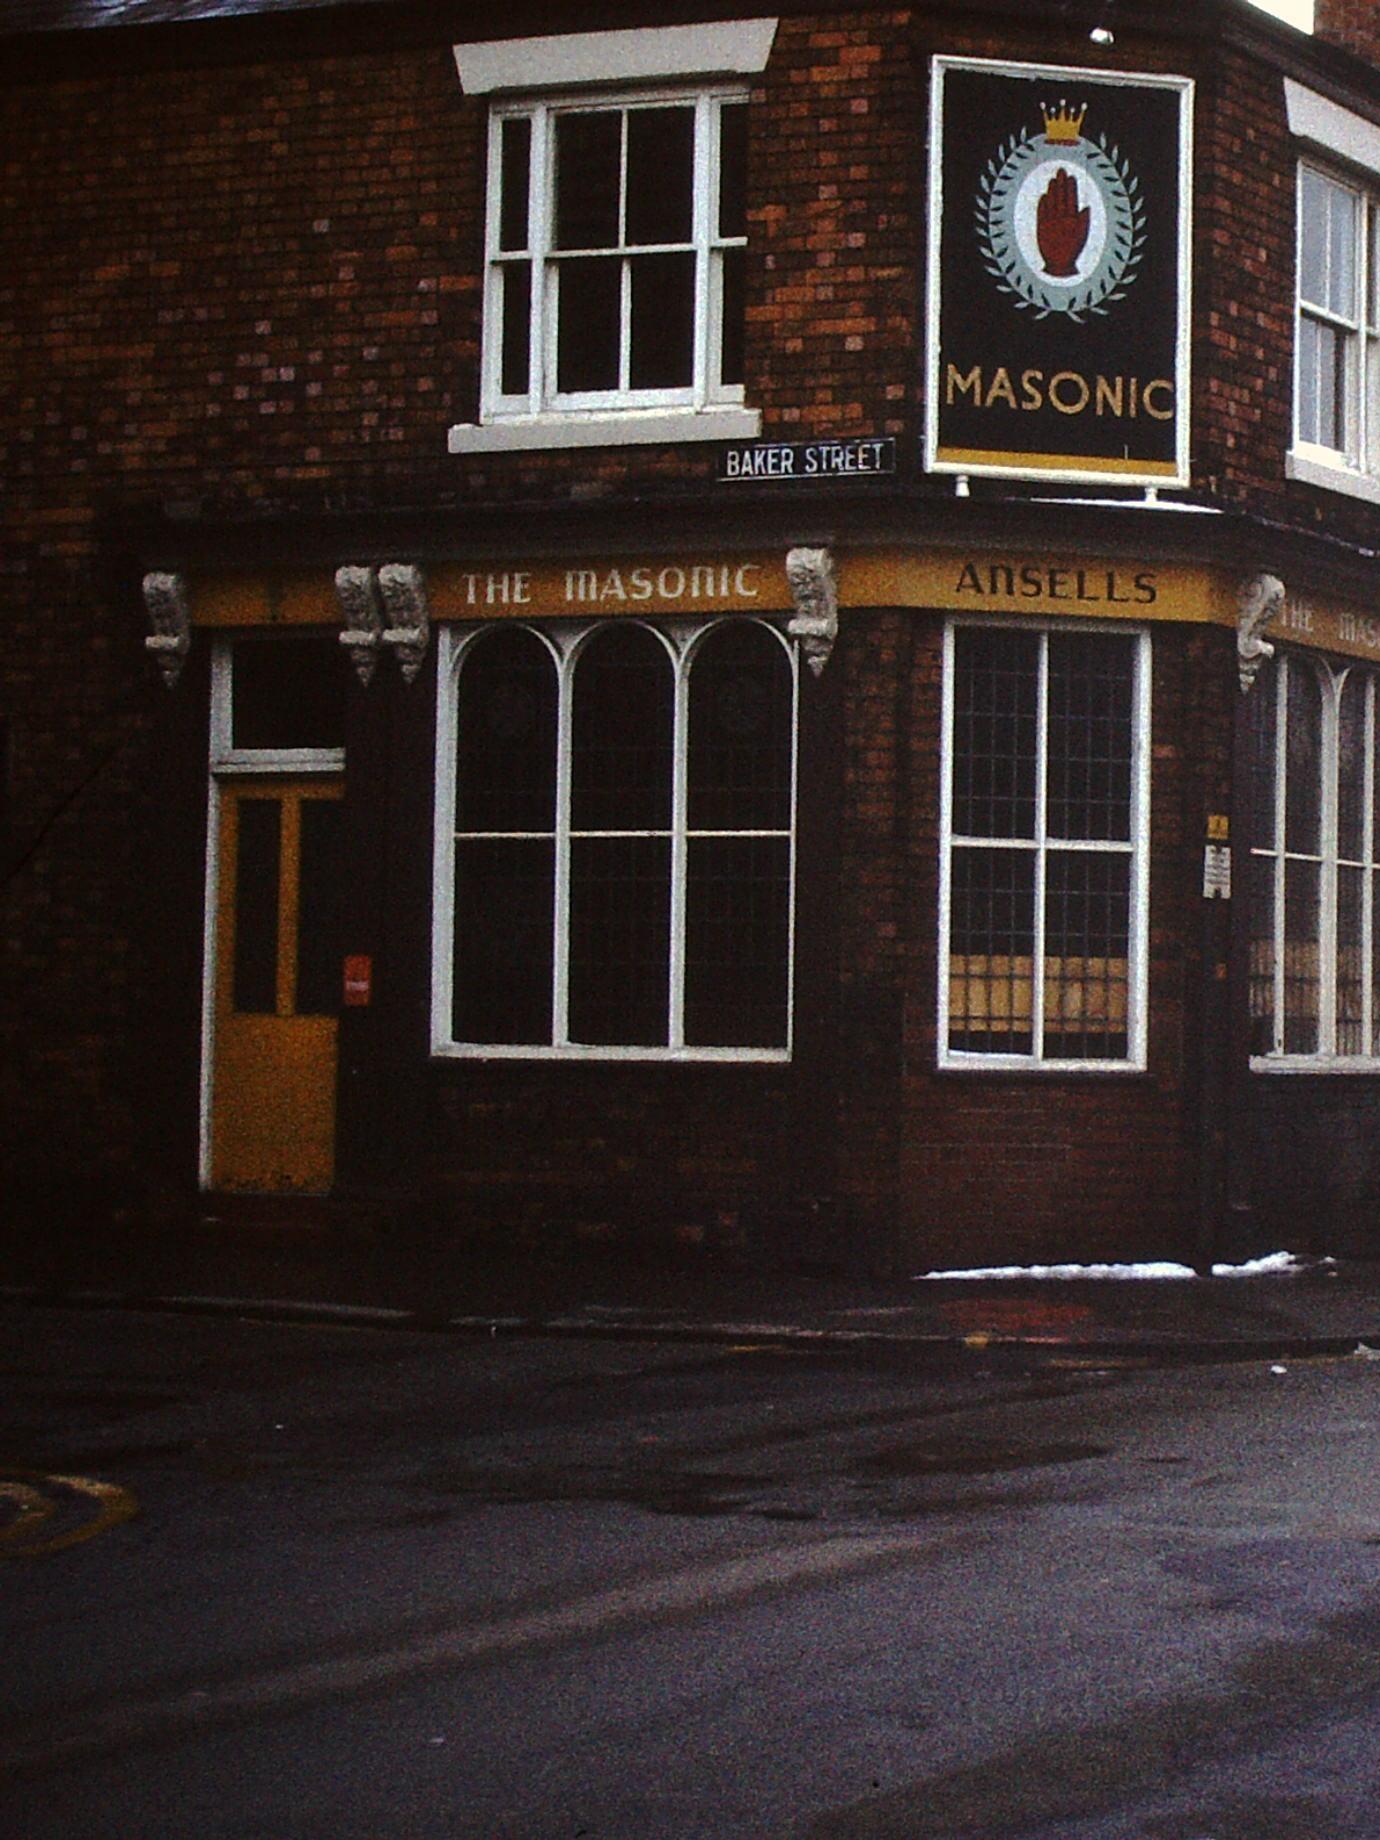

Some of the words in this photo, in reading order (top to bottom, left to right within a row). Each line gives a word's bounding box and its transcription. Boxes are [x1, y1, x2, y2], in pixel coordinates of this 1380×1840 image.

[946, 364, 1174, 420] MASONIC
[727, 447, 793, 477] BAKER
[805, 443, 884, 473] STREET
[462, 571, 531, 604] THE
[565, 565, 761, 602] MASONIC
[955, 562, 1158, 604] ANSELLS
[1279, 598, 1314, 632] THE
